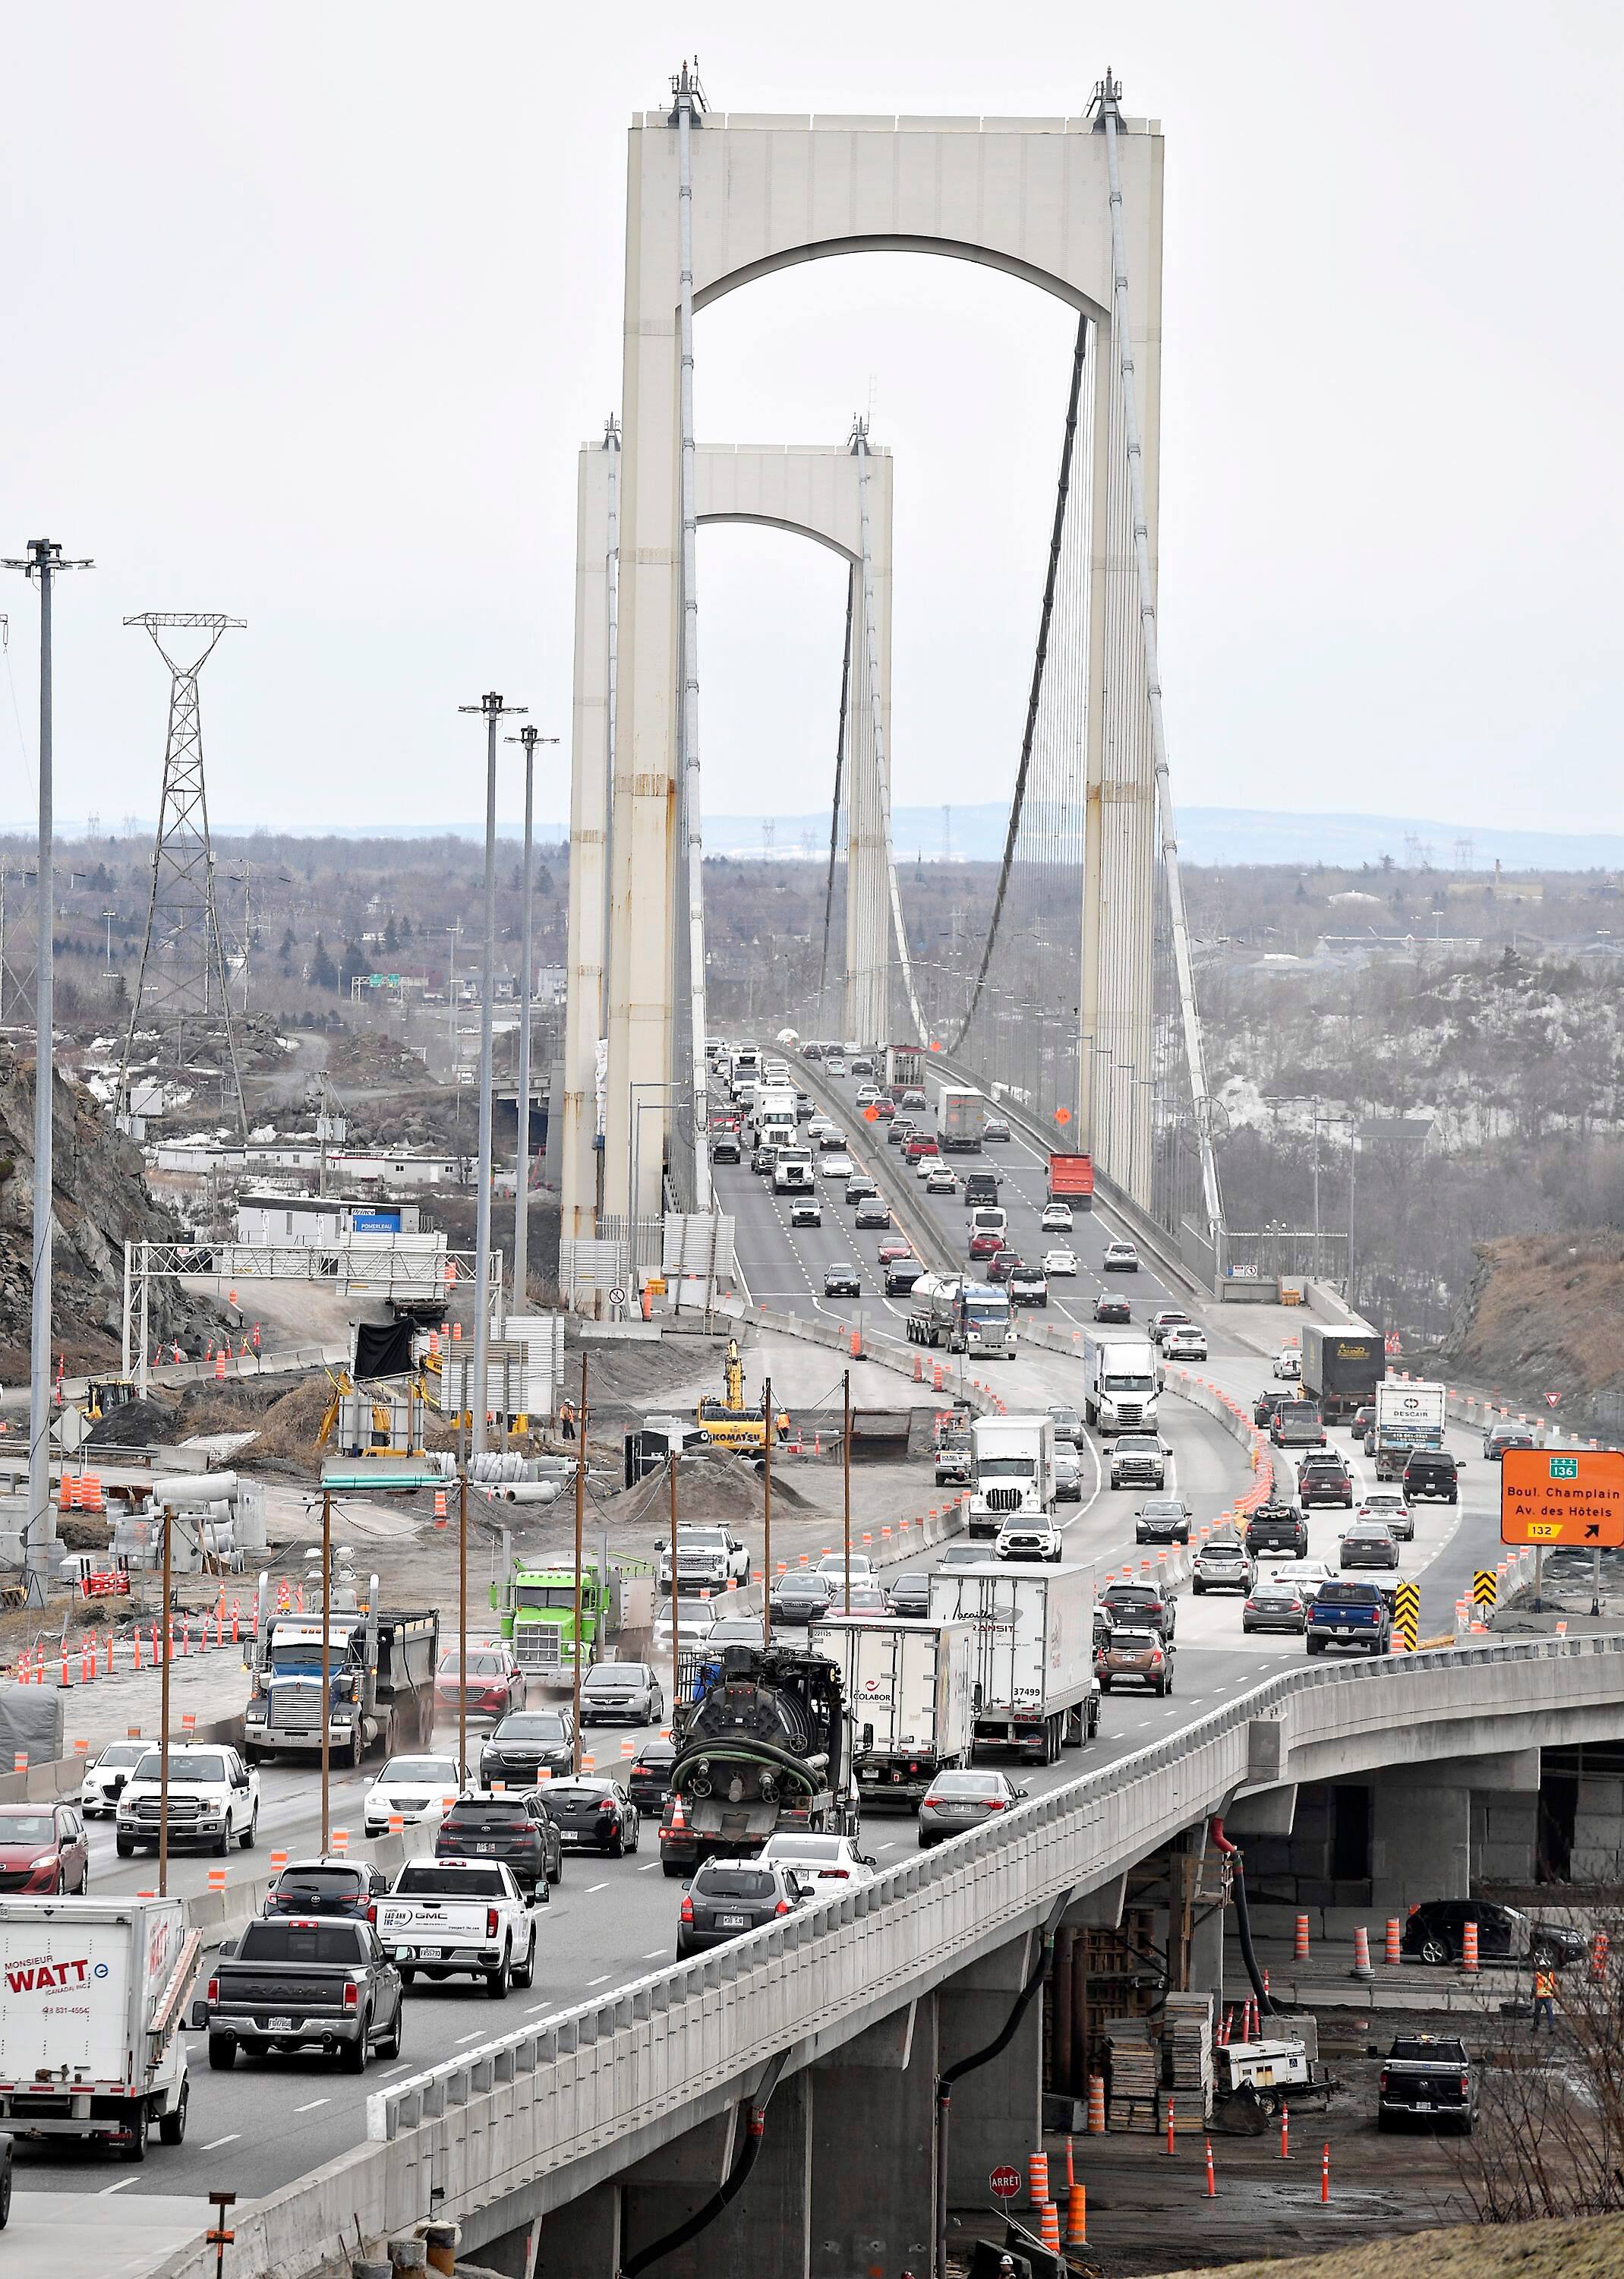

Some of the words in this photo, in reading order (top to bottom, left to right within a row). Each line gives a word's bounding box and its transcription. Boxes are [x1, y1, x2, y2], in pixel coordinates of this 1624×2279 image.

[1553, 1466, 1574, 1476] 136
[1507, 1486, 1540, 1497] Boul.
[1546, 1488, 1619, 1500] Champlain
[1515, 1505, 1535, 1515] Av.
[1541, 1506, 1563, 1516] des
[1569, 1507, 1612, 1517] Hôtels
[1532, 1526, 1552, 1535] 132
[972, 1624, 1016, 1633] RANSIT
[853, 1693, 891, 1701] COLABOR
[1014, 1687, 1040, 1696] 37499
[4, 1955, 53, 1971] MONSIEUR
[7, 1959, 89, 1993] WATT
[244, 1984, 317, 1996] RAM
[992, 2175, 1020, 2187] ARRÊT
